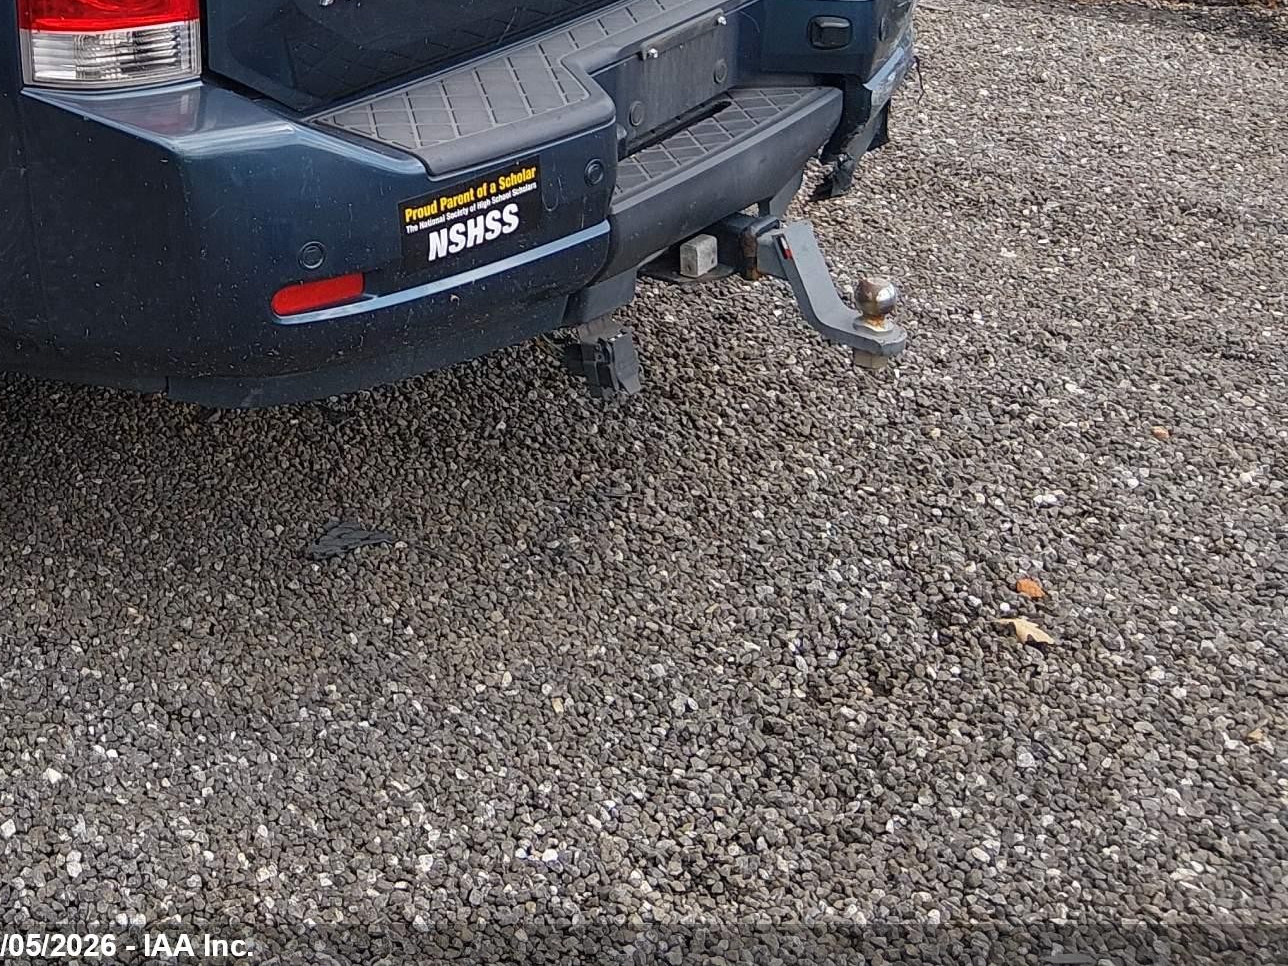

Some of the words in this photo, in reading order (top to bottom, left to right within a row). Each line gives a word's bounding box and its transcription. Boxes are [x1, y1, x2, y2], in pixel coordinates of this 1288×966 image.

[405, 199, 438, 222] Proud
[440, 187, 475, 211] Parent
[476, 182, 488, 198] of
[489, 182, 497, 194] a
[498, 167, 537, 190] Scholar
[405, 224, 419, 234] The
[419, 214, 446, 230] National
[446, 207, 469, 221] Society
[469, 203, 477, 213] of
[477, 198, 491, 210] High
[491, 190, 512, 204] School
[512, 181, 537, 197] Scholars
[428, 203, 520, 261] NSHSS
